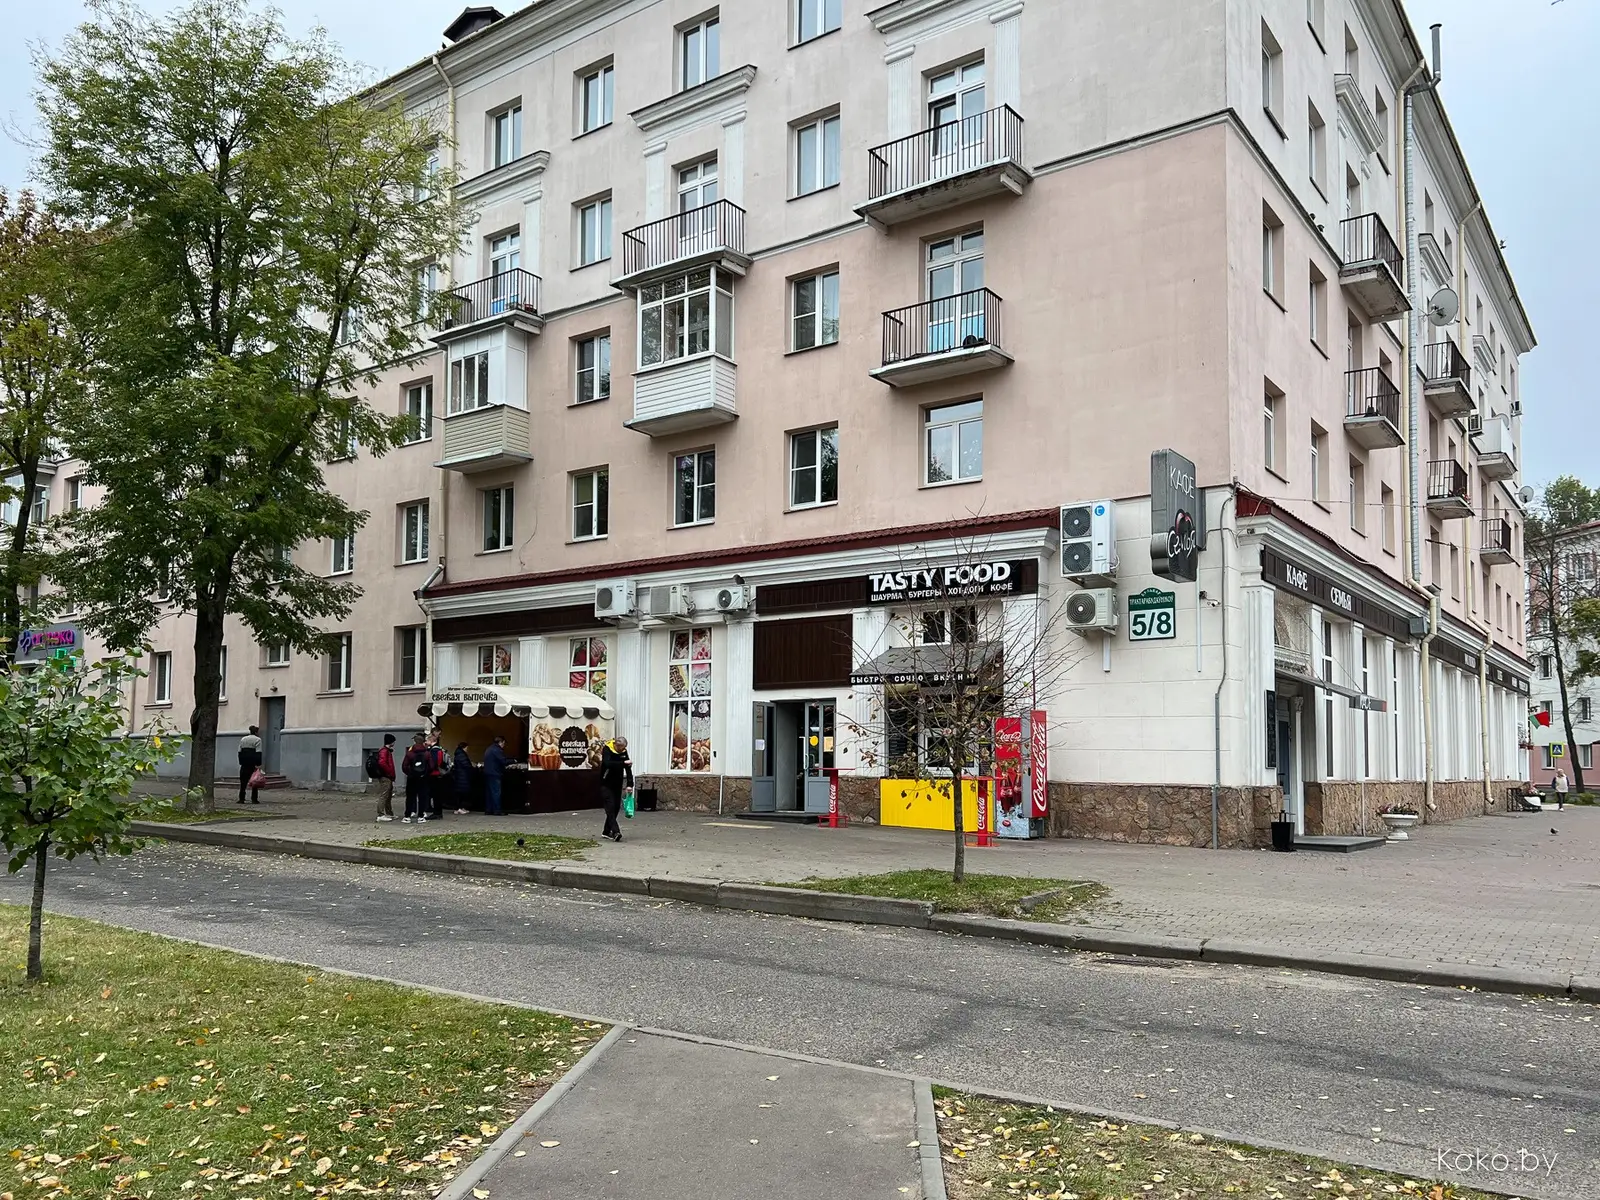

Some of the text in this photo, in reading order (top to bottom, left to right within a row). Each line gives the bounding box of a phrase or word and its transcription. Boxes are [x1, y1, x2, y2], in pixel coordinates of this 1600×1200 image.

[1169, 465, 1195, 499] КАФЕ
[869, 562, 1011, 592] TASTY FOOD
[871, 592, 903, 601] ШАУРМА
[908, 588, 942, 598] БУРГЕРЫ
[990, 582, 1013, 592] КОФЕ
[1286, 563, 1352, 611] КАФЕ СЕМЬЯ
[1132, 611, 1172, 636] 5/8
[1032, 717, 1046, 812] Coca-Cola
